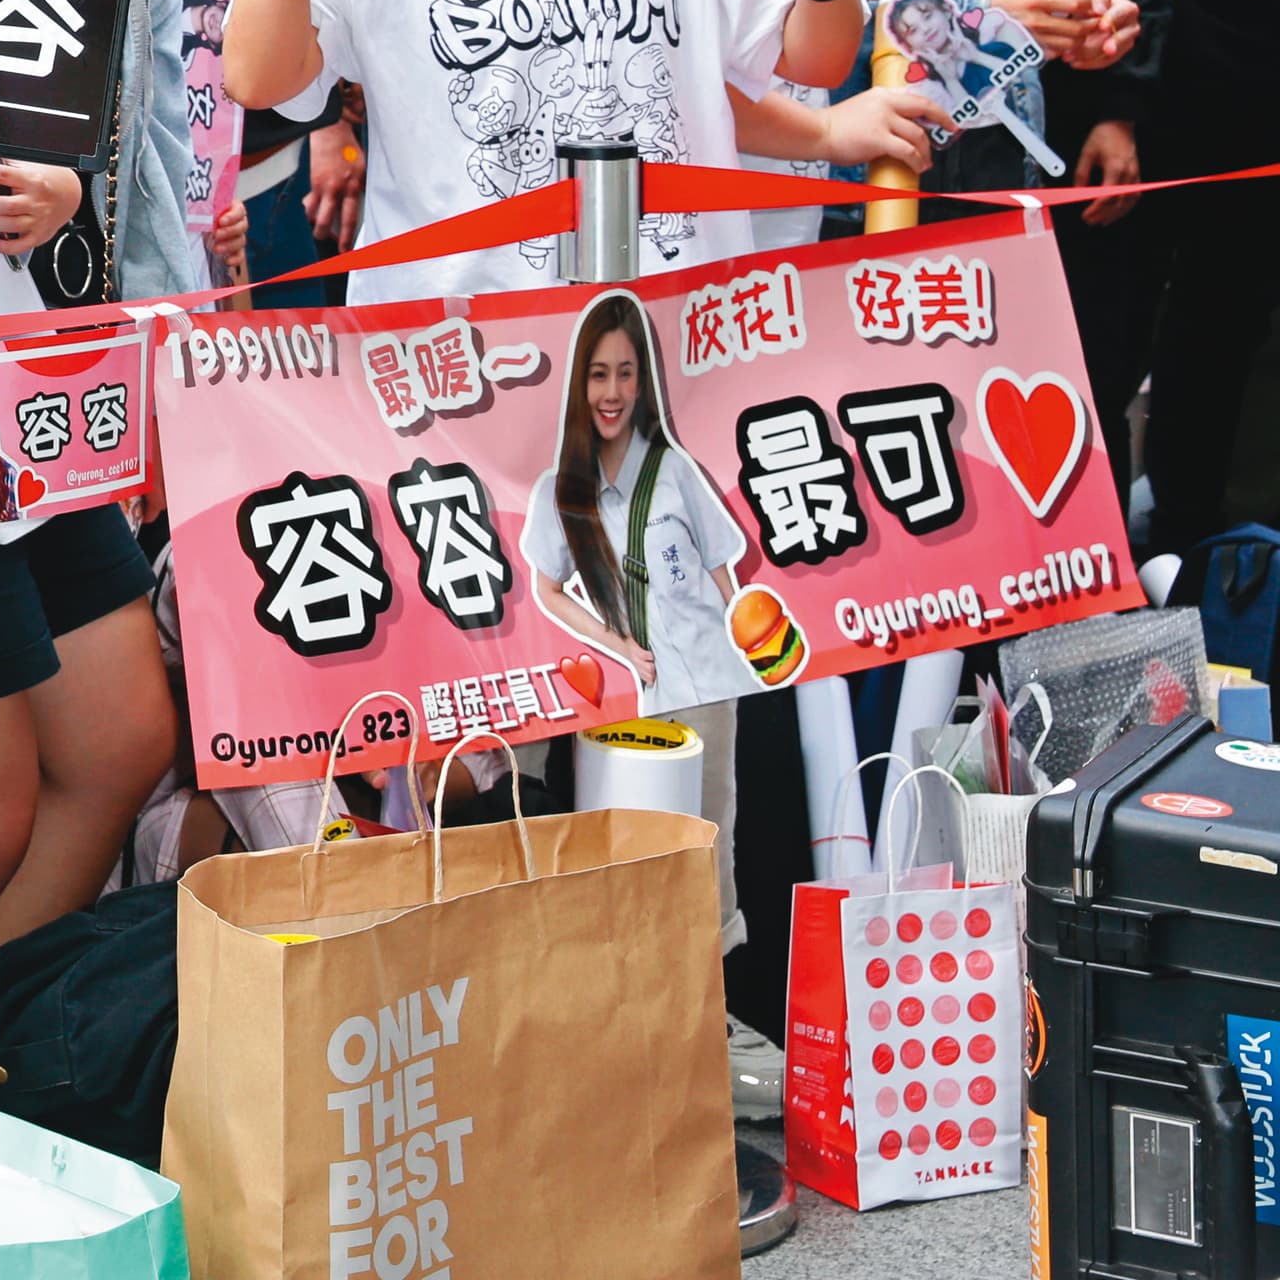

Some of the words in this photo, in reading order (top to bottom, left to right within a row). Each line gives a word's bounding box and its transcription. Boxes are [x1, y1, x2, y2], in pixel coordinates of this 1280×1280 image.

[993, 42, 1041, 85] rong
[933, 98, 980, 144] rng
[165, 321, 339, 387] 19991107
[16, 383, 128, 464] 容容
[66, 456, 140, 488] @yurong_ccc1107
[249, 466, 506, 646] 容容
[744, 393, 948, 552] 最可
[833, 542, 1118, 653] @yurong_ccc1107
[210, 709, 412, 770] @yurong_823
[327, 976, 469, 1084] ONLY
[328, 1058, 438, 1156] THE
[328, 1116, 473, 1227] BEST
[914, 1159, 995, 1186] YANNICK
[328, 1198, 454, 1280] FOR
